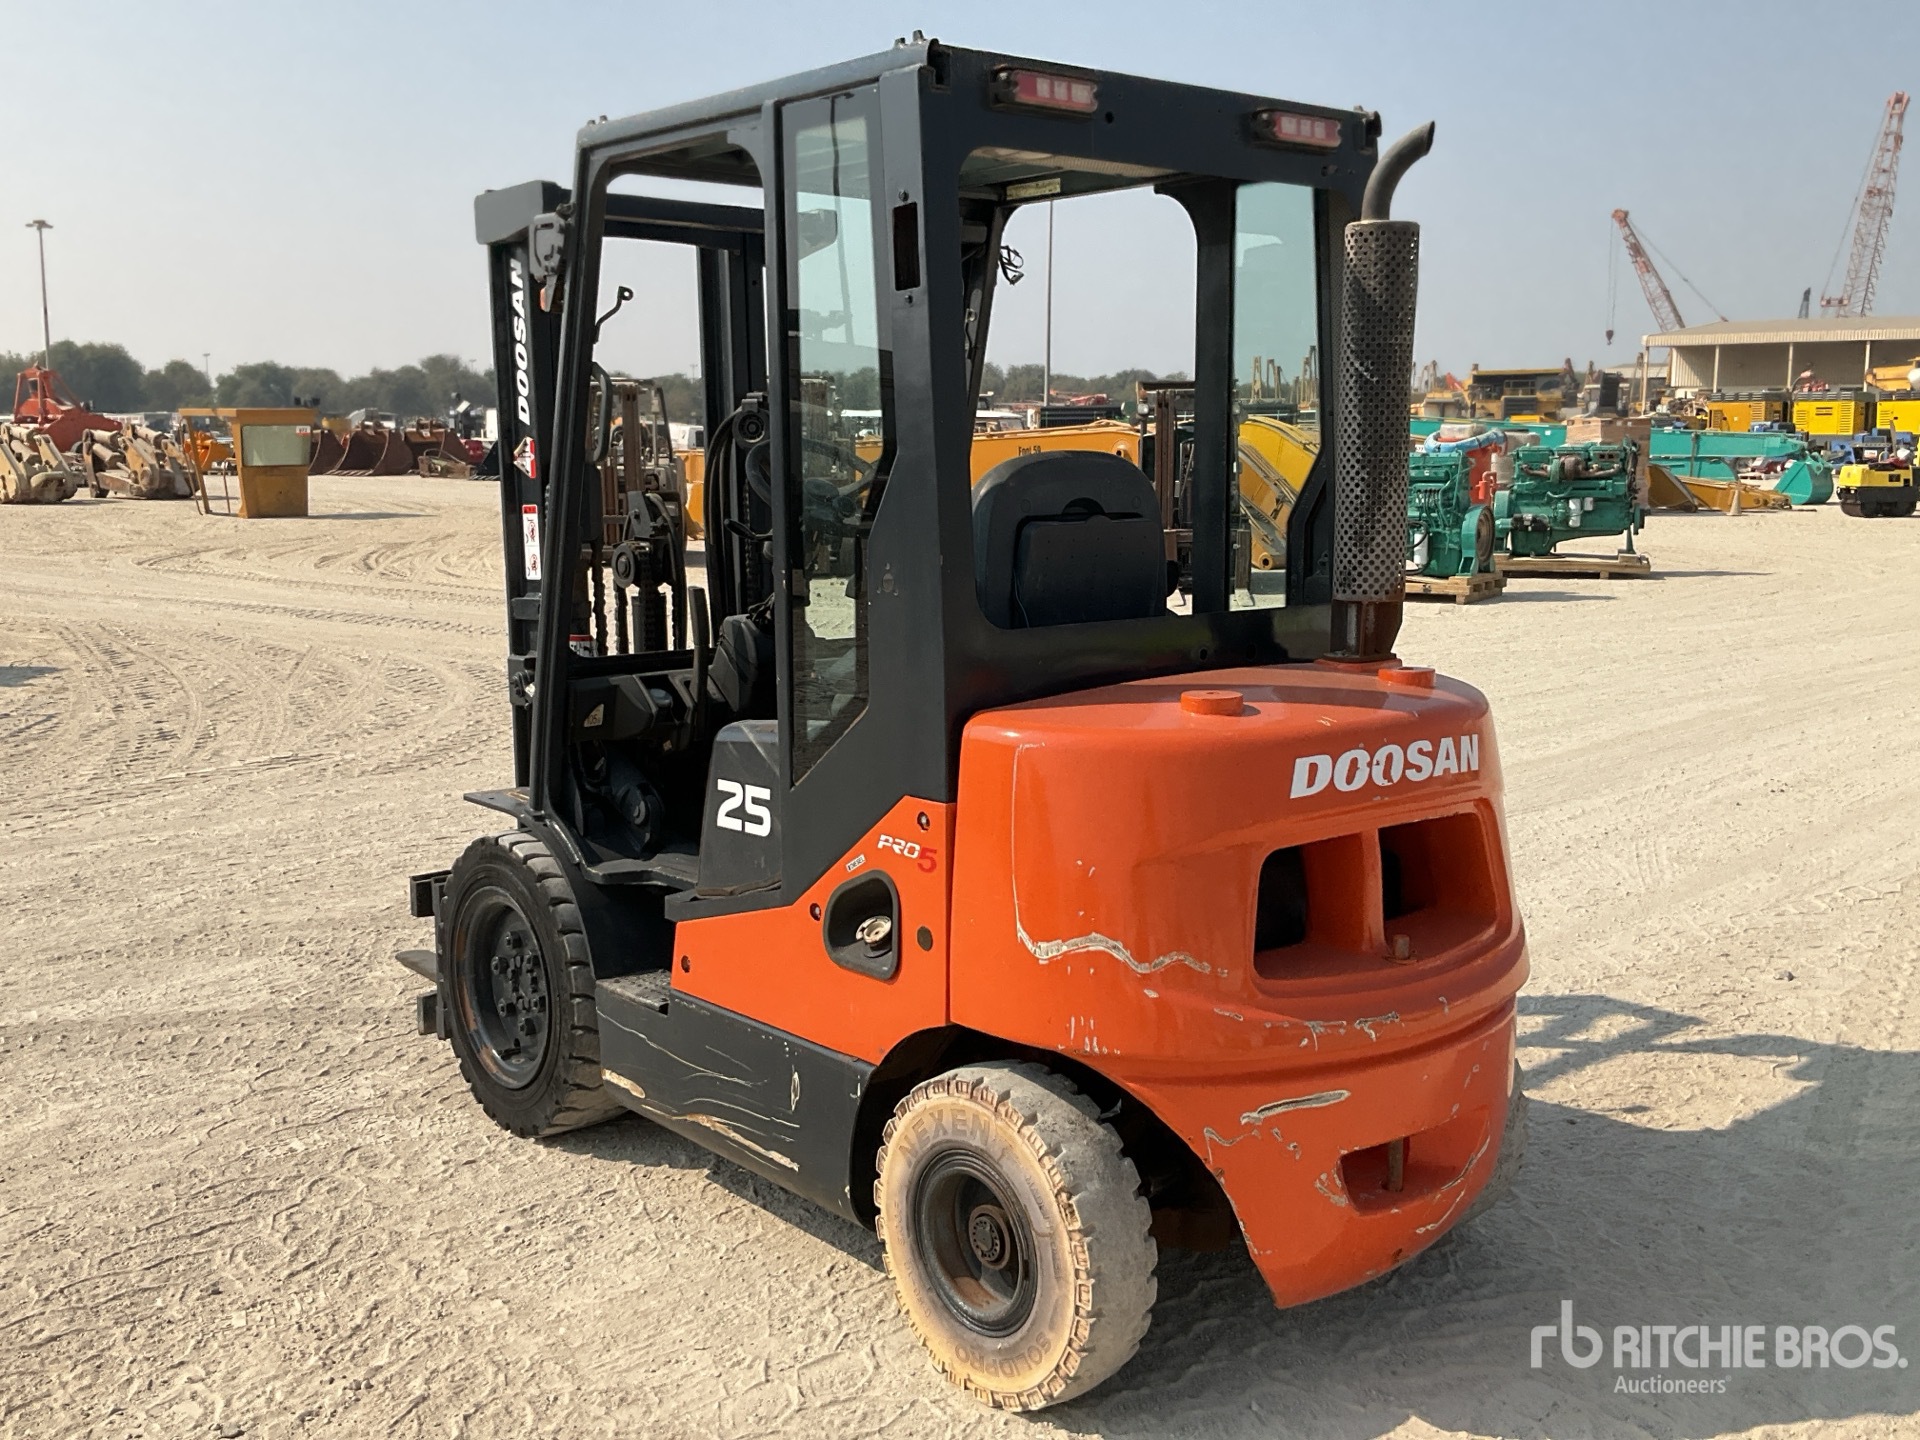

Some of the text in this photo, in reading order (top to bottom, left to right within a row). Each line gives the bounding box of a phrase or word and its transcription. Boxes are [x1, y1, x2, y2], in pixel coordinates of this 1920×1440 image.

[510, 258, 530, 426] DOOSAN
[1290, 734, 1479, 799] DOOSAN
[717, 779, 771, 837] 25
[899, 1109, 990, 1168] NEXEN
[955, 1332, 1051, 1377] SOLIDPRO
